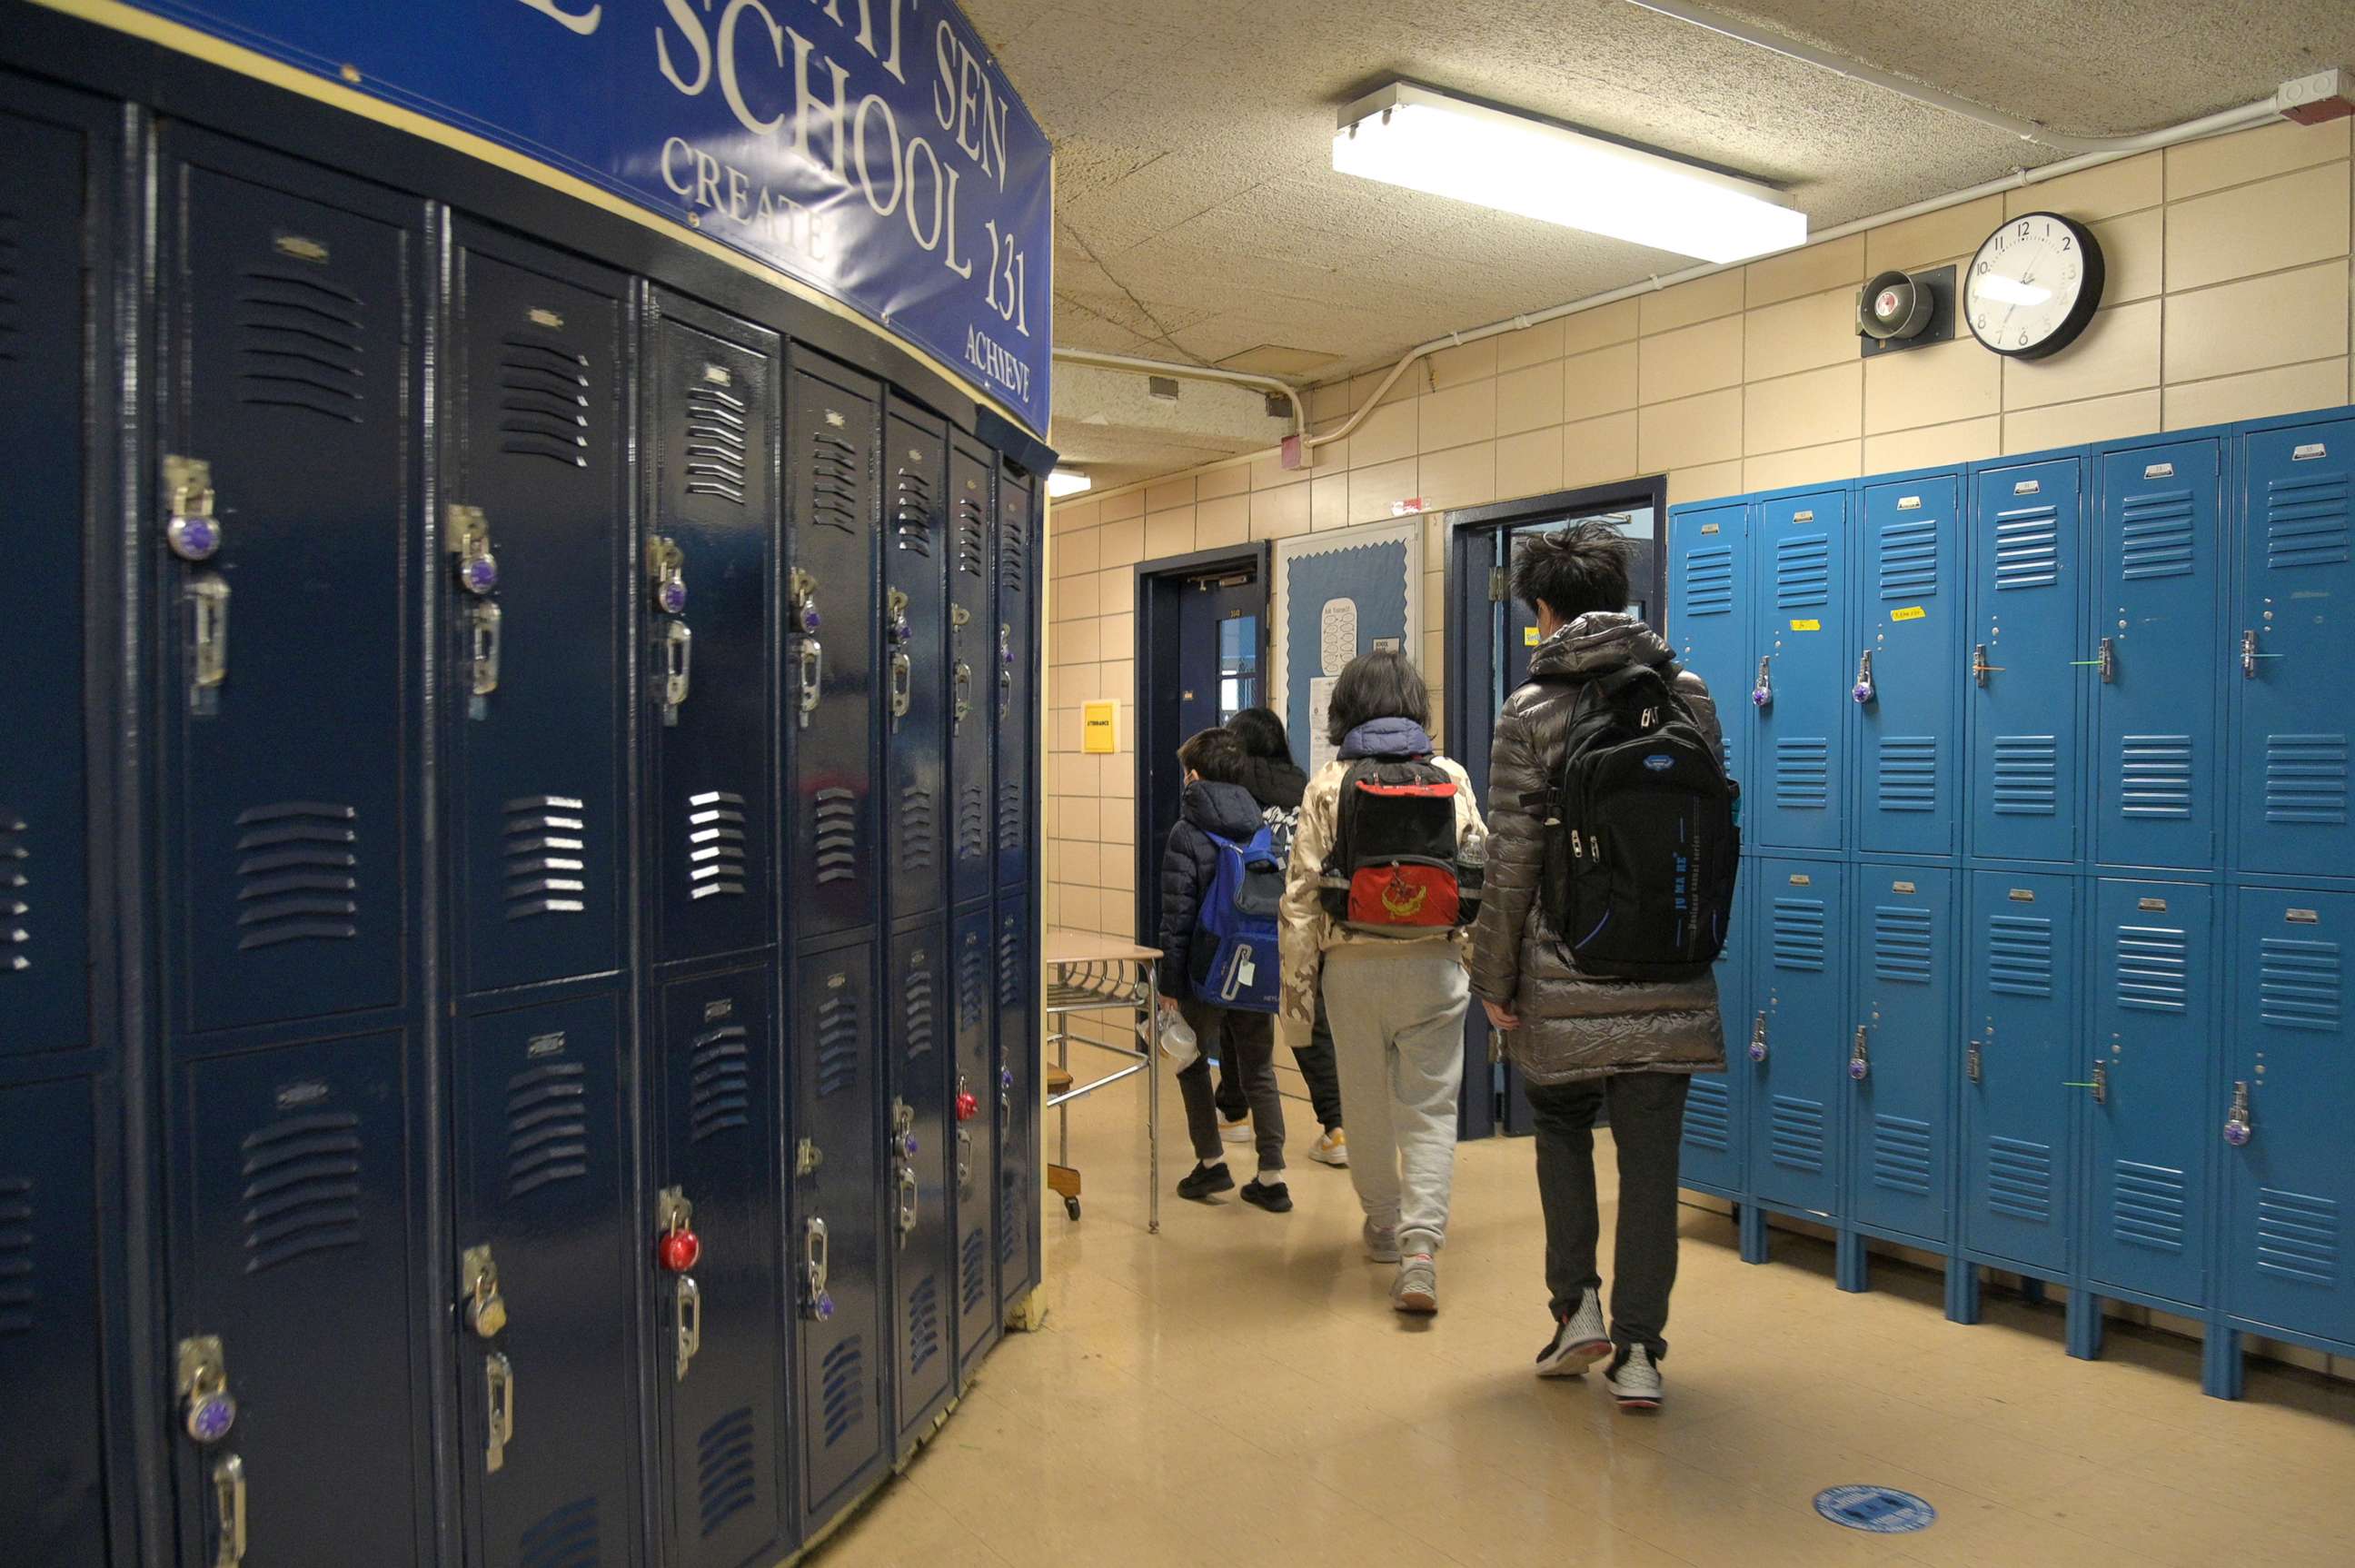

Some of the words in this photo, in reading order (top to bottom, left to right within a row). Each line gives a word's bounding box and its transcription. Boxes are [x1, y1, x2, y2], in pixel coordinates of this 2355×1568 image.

[934, 19, 1009, 194] SEN
[656, 0, 972, 279] SCHOOL
[985, 218, 1030, 338] 131
[661, 136, 826, 263] CREATE
[2017, 221, 2030, 237] 12
[1994, 235, 2003, 251] 11
[2062, 236, 2071, 252] 2
[1976, 261, 1988, 276] 10
[2067, 263, 2076, 280] 3
[1977, 313, 1986, 330] 8
[1995, 330, 2003, 345] 7
[2019, 331, 2029, 346] 6
[965, 323, 1030, 403] ACHIEVE
